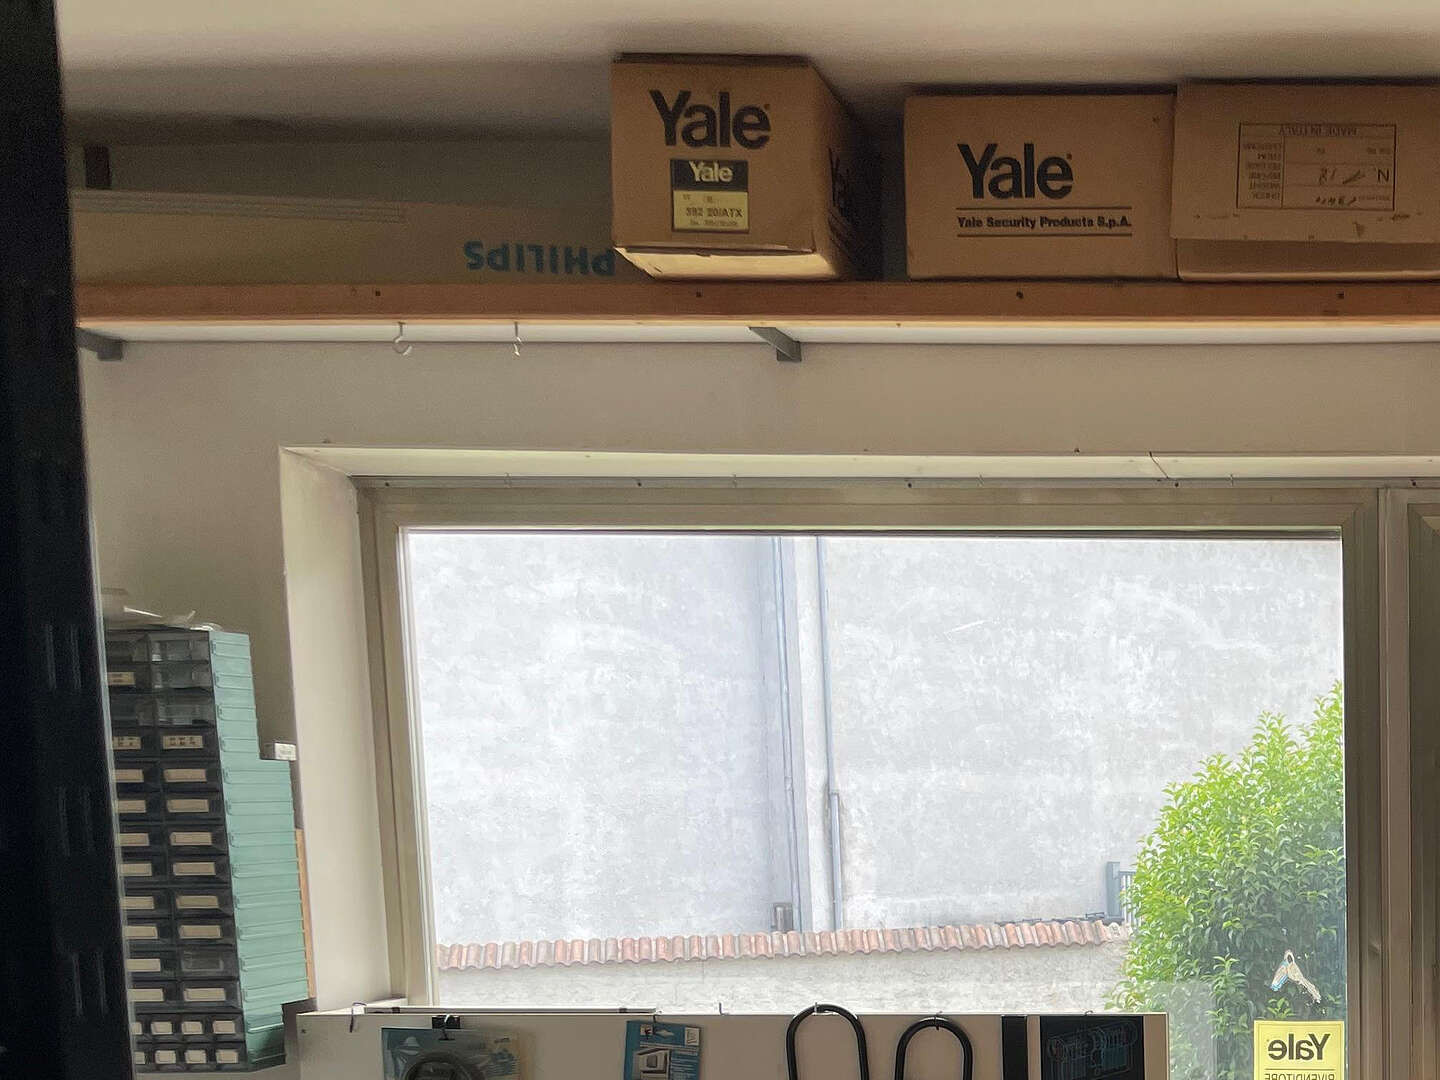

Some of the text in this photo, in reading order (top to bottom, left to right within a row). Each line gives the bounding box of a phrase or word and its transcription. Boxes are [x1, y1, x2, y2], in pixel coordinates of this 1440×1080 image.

[649, 89, 770, 150] Yale
[688, 161, 734, 183] Yale
[956, 142, 1072, 199] Yale
[957, 217, 985, 229] Yale
[987, 217, 1036, 231] Security
[1039, 217, 1093, 229] Products
[464, 240, 615, 276] PHILIPS
